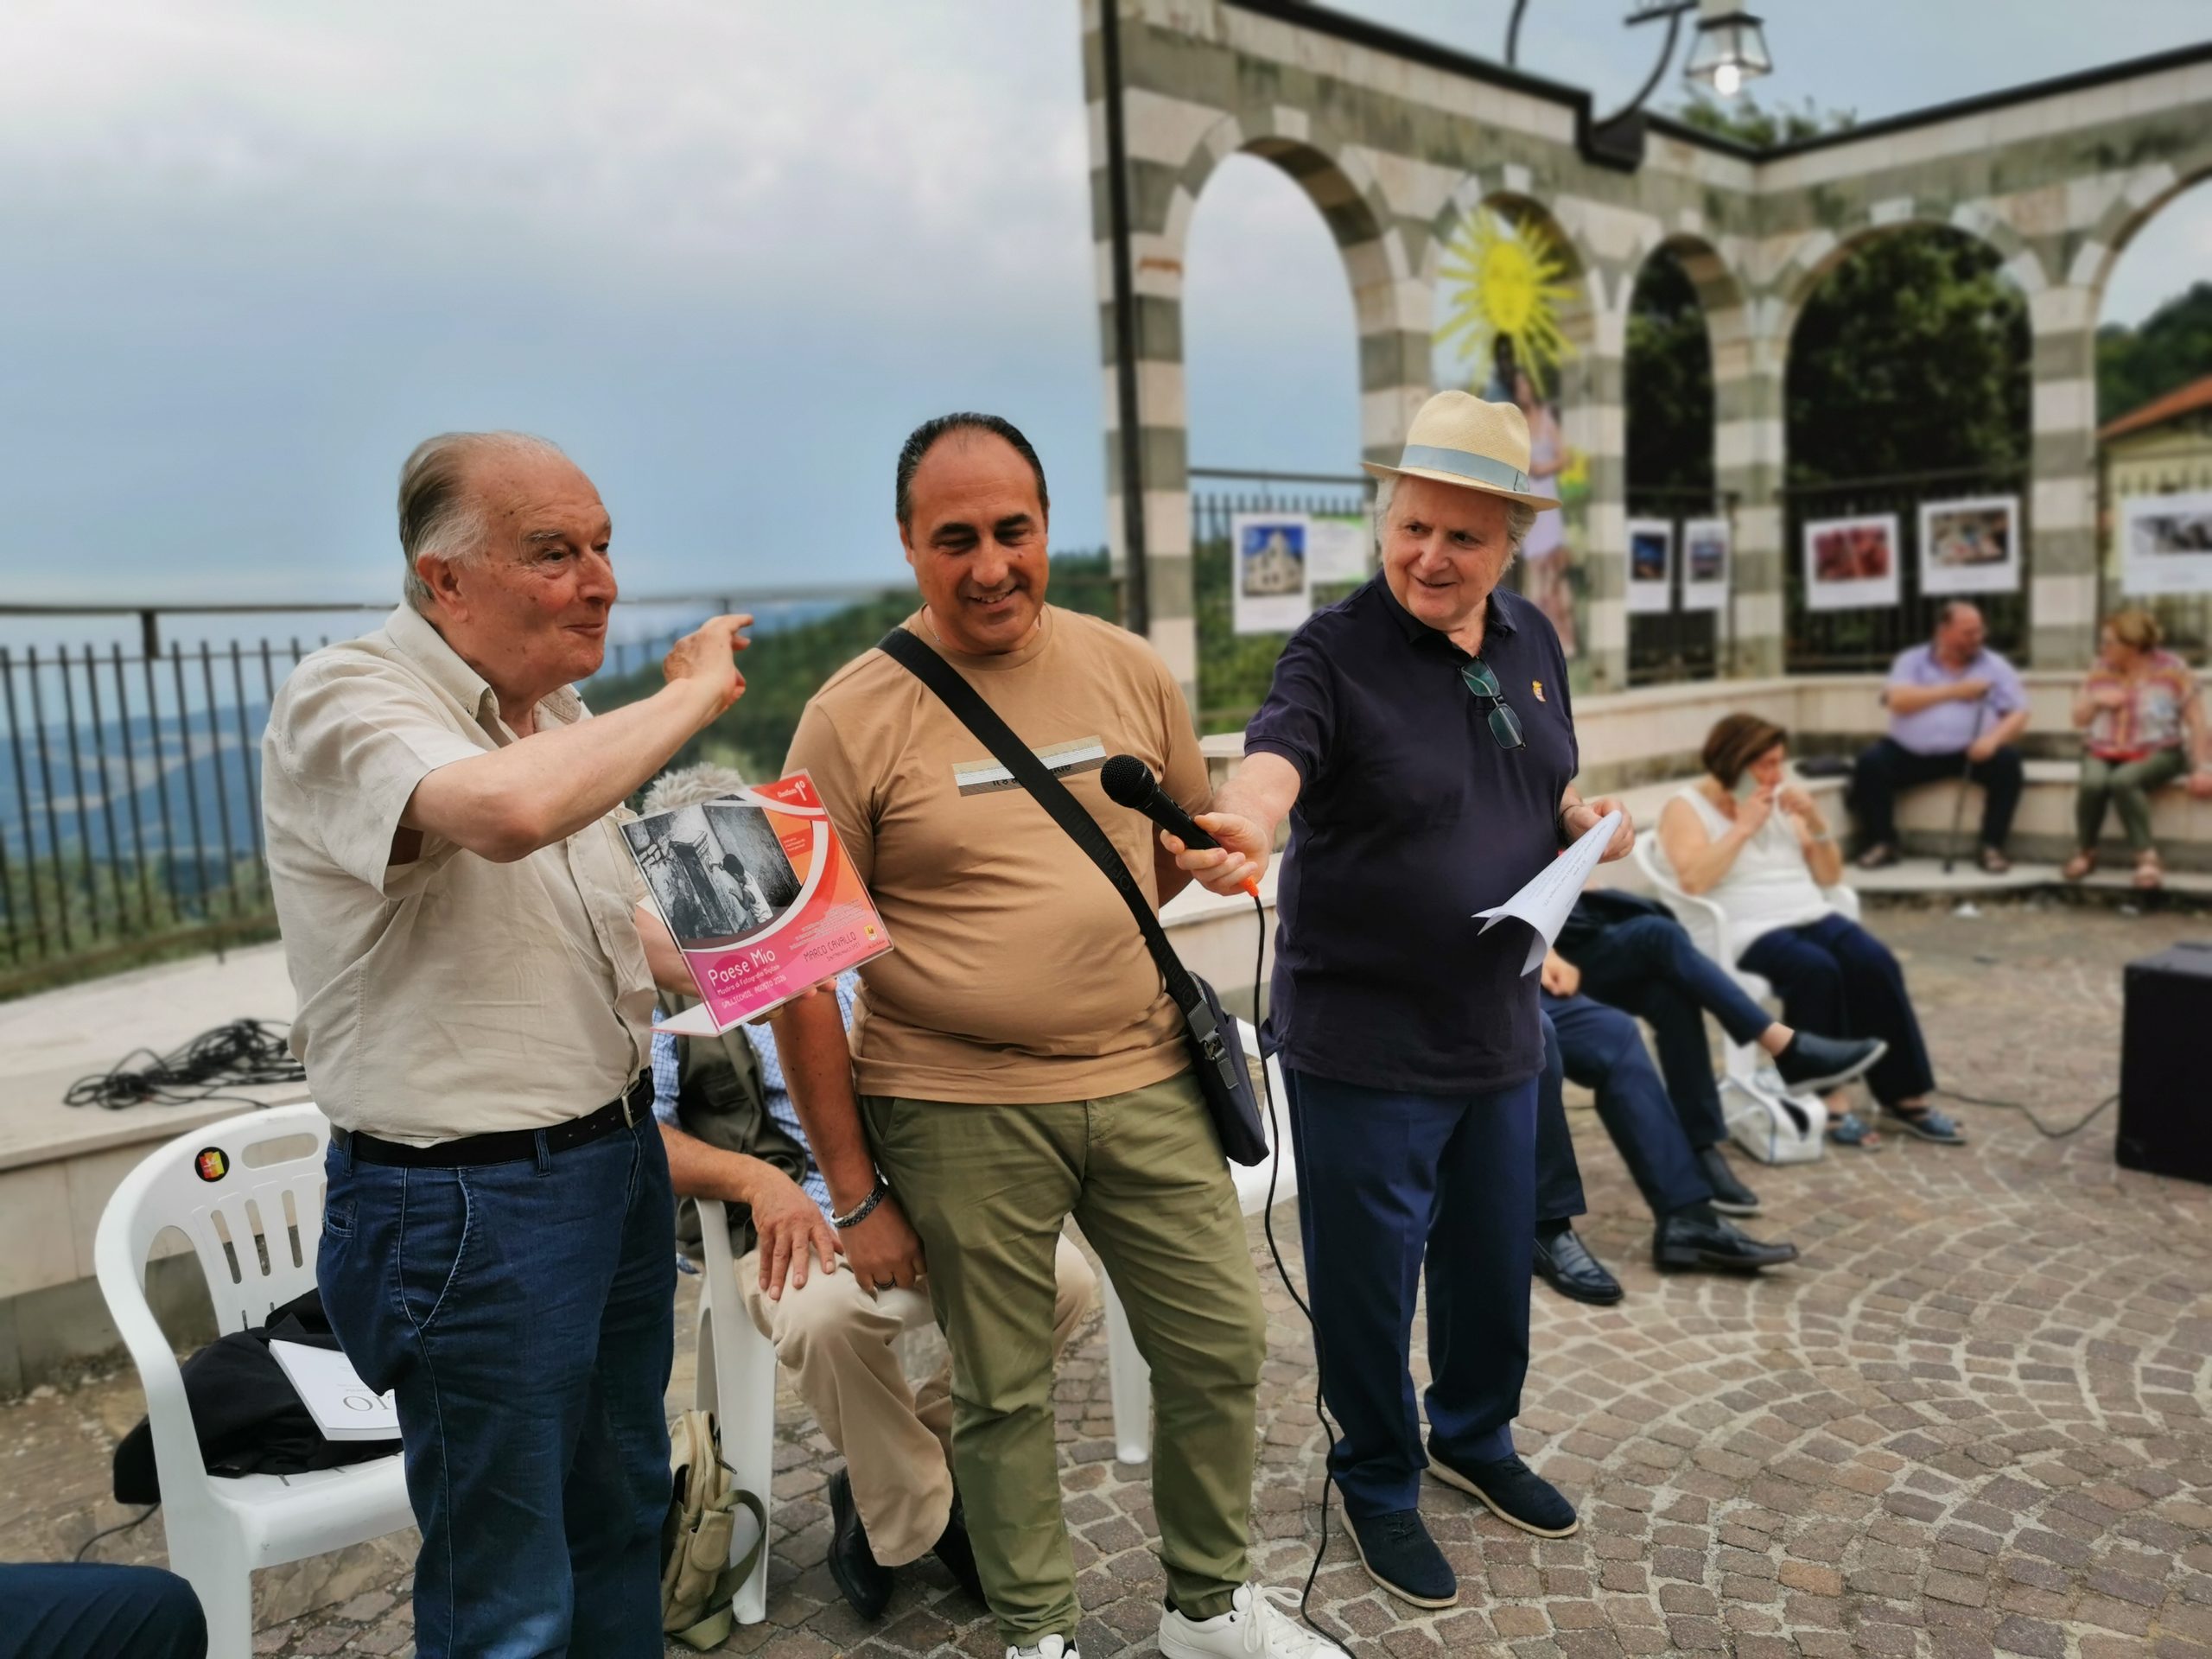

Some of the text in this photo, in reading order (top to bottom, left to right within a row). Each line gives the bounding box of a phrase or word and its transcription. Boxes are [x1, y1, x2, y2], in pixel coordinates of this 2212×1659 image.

[804, 944, 827, 963] MARCO
[827, 932, 857, 954] CAVALLO
[708, 948, 776, 987] Paese Mio
[754, 980, 775, 996] AGOSTO
